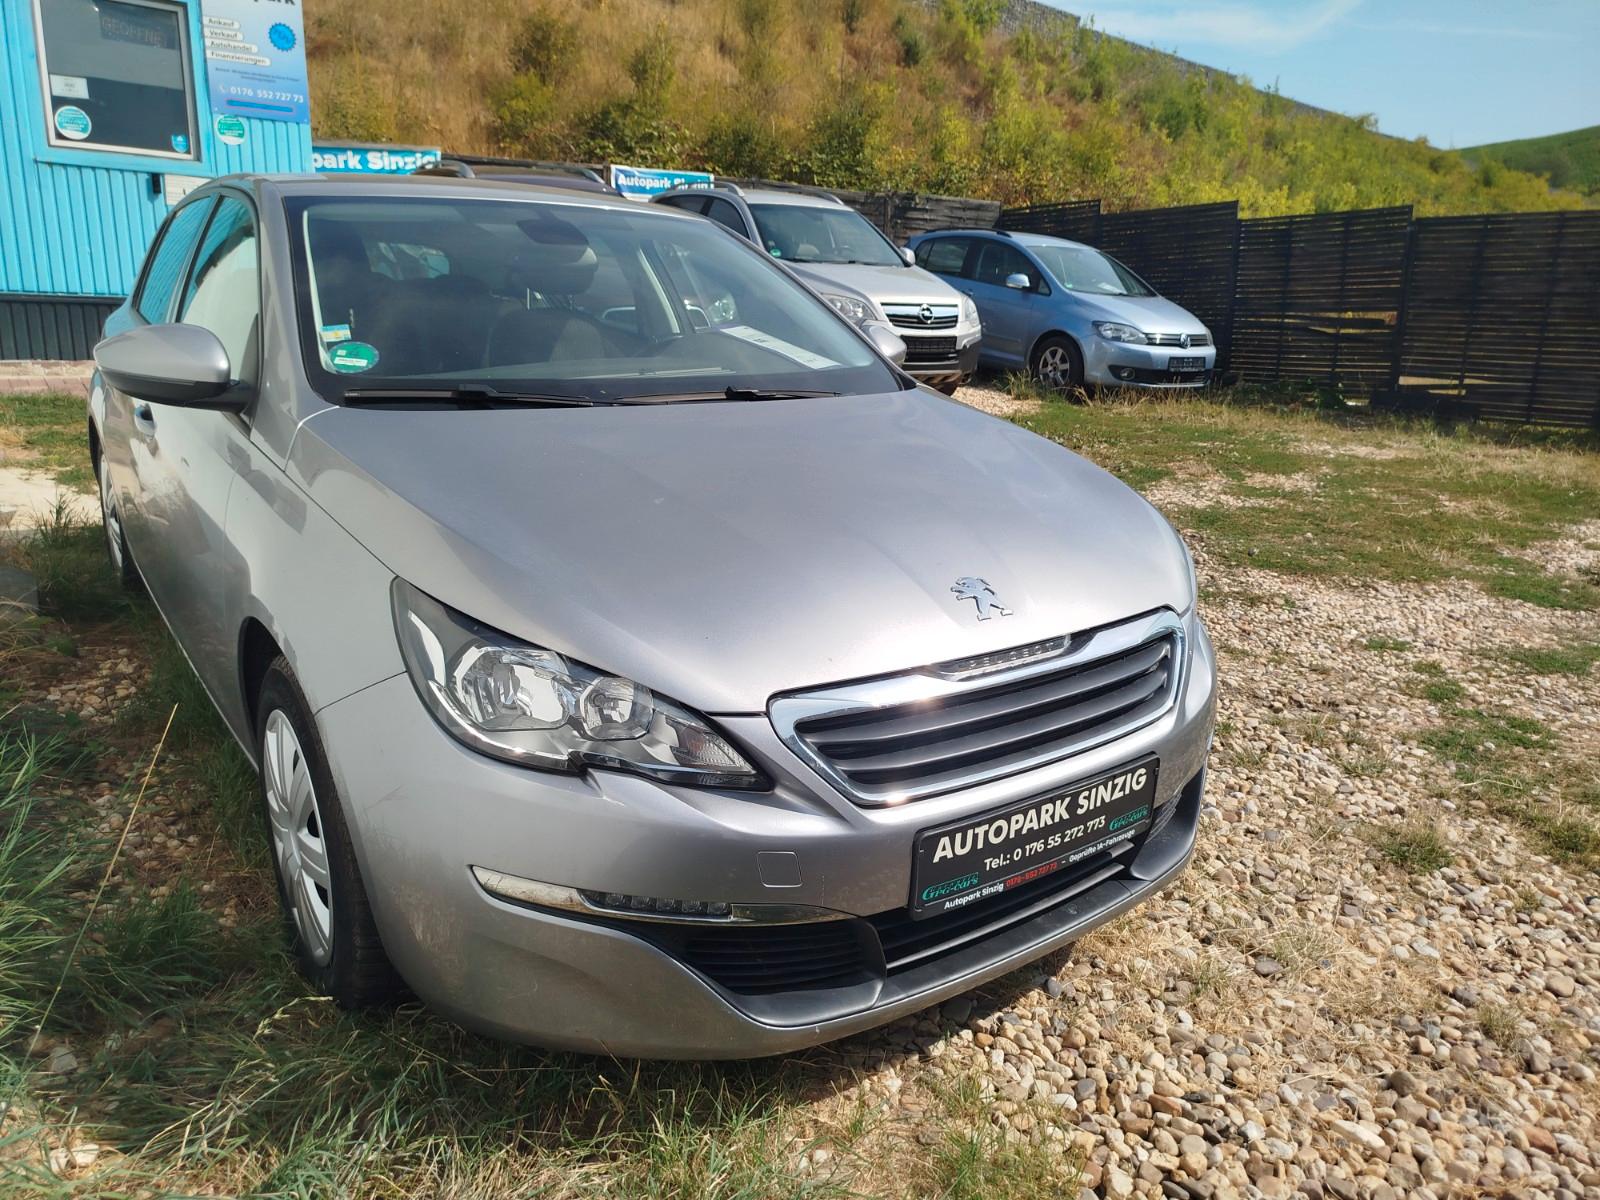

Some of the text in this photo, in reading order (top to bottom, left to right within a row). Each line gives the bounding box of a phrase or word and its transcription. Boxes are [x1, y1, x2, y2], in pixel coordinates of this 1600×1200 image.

[208, 18, 235, 27] Ankauf
[209, 29, 238, 38] Verkauf
[210, 40, 253, 51] Autohandel
[229, 86, 254, 97] 0176
[618, 173, 671, 190] Autopark
[967, 641, 1054, 668] PEUGEOT
[933, 767, 1147, 863] AUTOPARK SINZIG
[984, 815, 1106, 871] Tel.: 0 176 55 272 773
[944, 890, 981, 910] Autopark
[981, 882, 1004, 898] Sinzig
